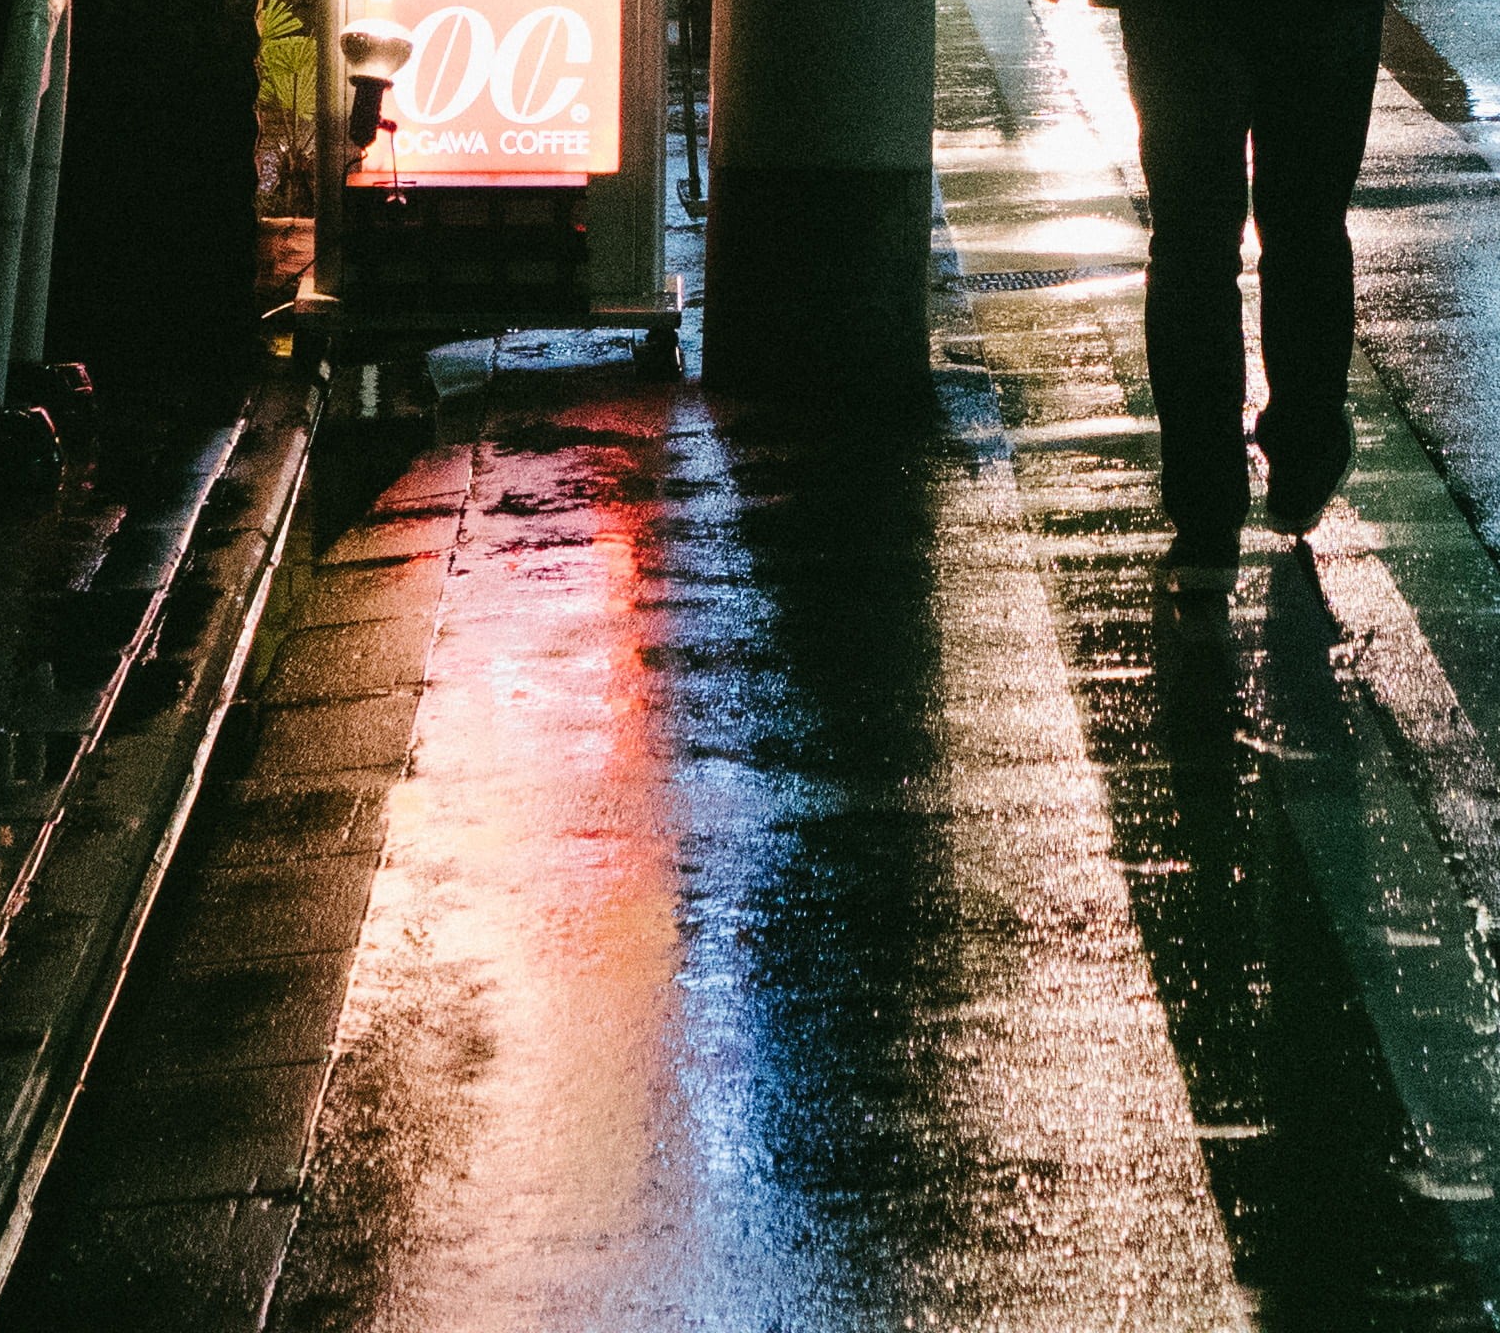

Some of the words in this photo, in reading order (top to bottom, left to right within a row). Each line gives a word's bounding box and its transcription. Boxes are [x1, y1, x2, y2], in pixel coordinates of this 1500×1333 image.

[392, 5, 594, 125] OC
[393, 130, 489, 155] OGAWA
[499, 130, 591, 155] COFFEE
